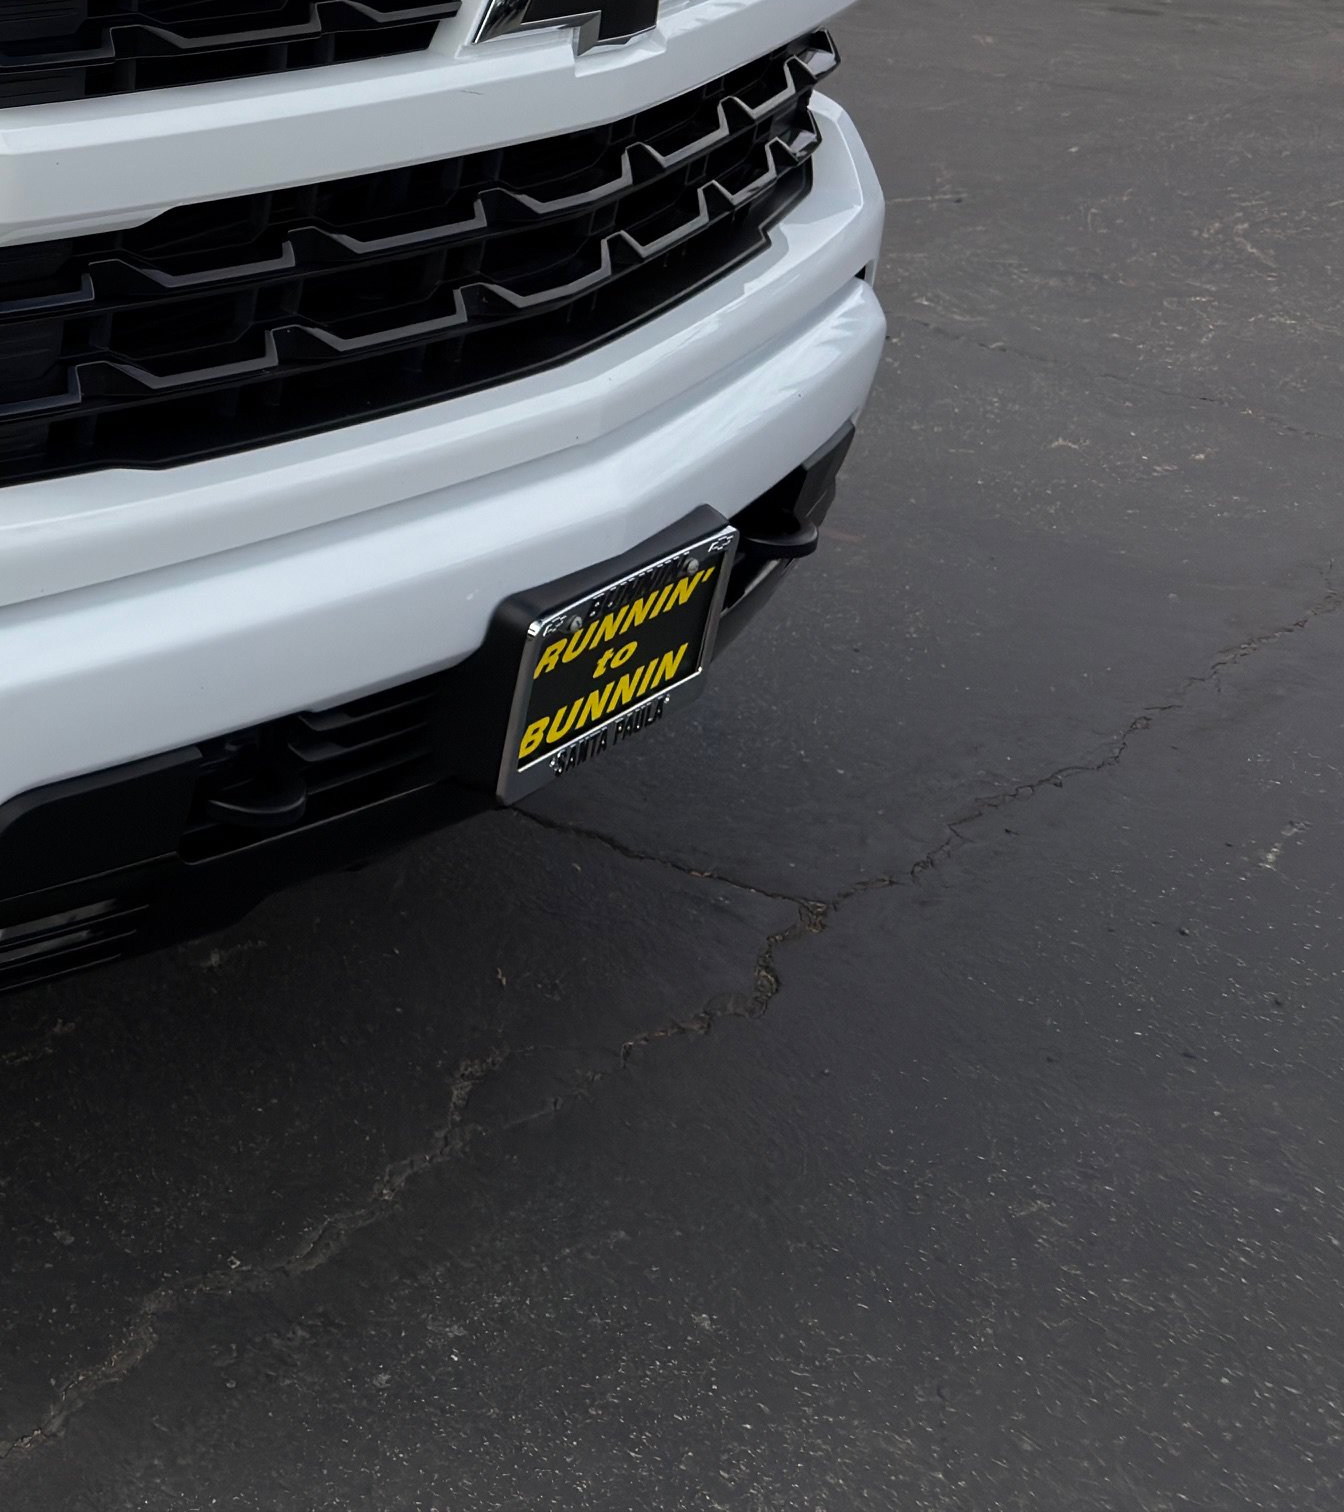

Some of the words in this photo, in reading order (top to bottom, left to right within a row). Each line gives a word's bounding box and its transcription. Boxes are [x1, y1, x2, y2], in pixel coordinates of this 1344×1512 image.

[593, 640, 638, 679] to
[518, 642, 689, 760] BUNNIN
[614, 695, 664, 746] PAULA
